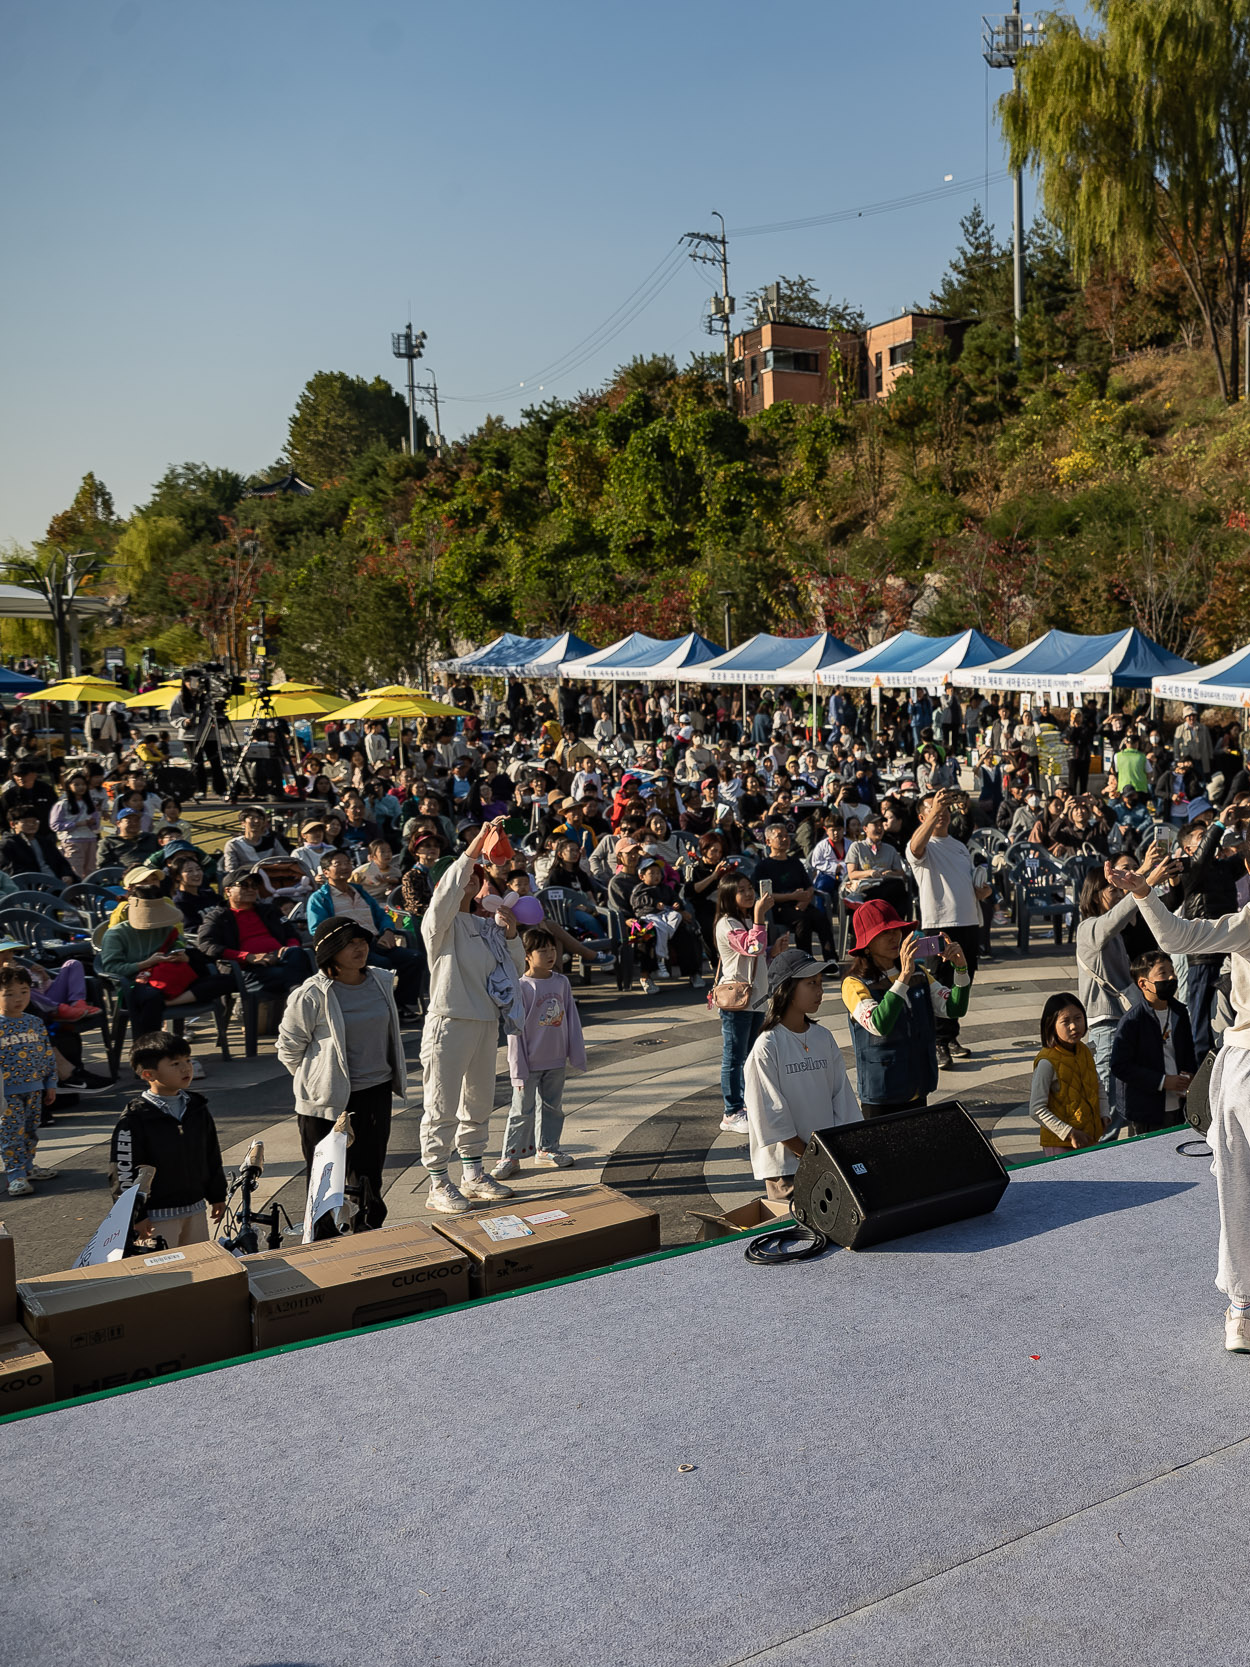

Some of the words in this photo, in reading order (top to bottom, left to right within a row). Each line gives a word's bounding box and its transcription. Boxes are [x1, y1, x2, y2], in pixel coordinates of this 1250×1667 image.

[117, 1129, 134, 1198] ONCLER
[392, 1264, 463, 1288] CUCKOO
[496, 1267, 510, 1278] SK
